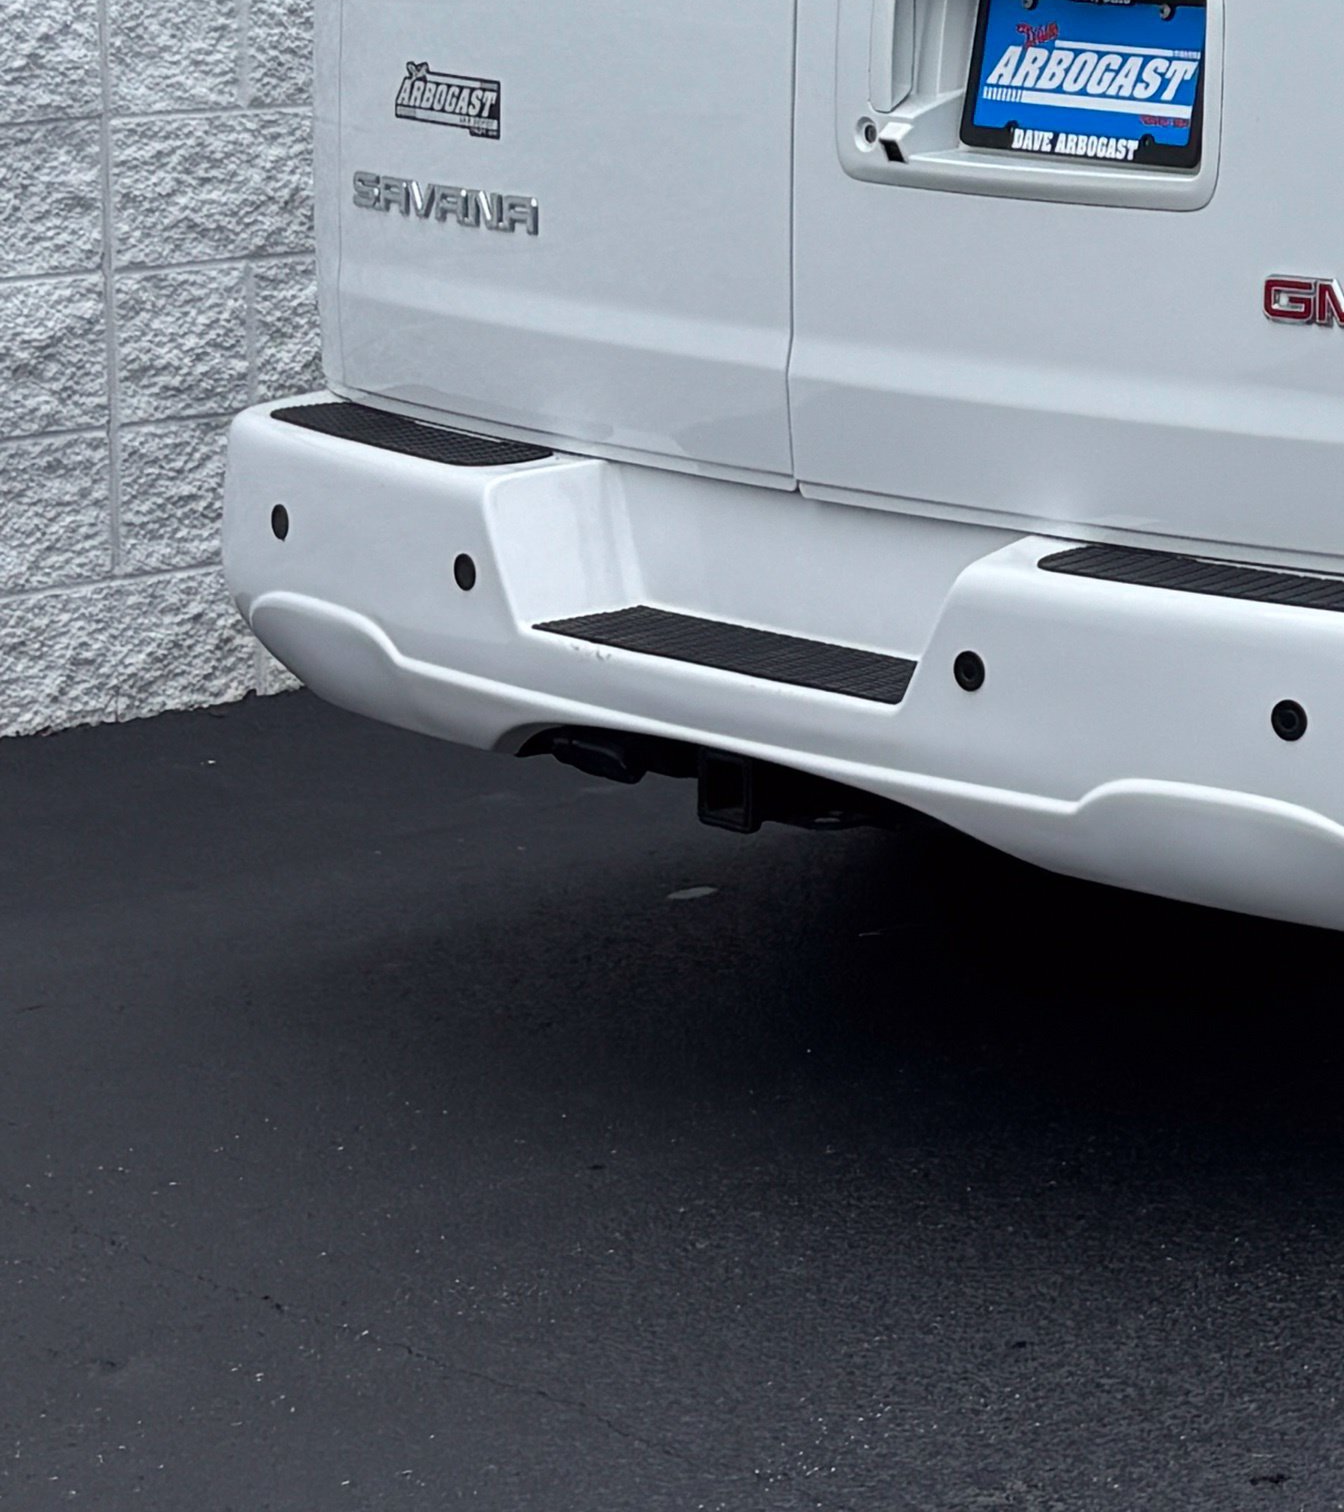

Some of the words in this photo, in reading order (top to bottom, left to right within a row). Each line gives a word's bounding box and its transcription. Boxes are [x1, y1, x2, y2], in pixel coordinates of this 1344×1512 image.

[986, 45, 1199, 102] ARBOGAST
[397, 79, 498, 118] ARBOGAST
[1011, 128, 1053, 153] DAVE
[1055, 132, 1140, 161] ARBOGAST
[353, 170, 540, 236] SAVANA
